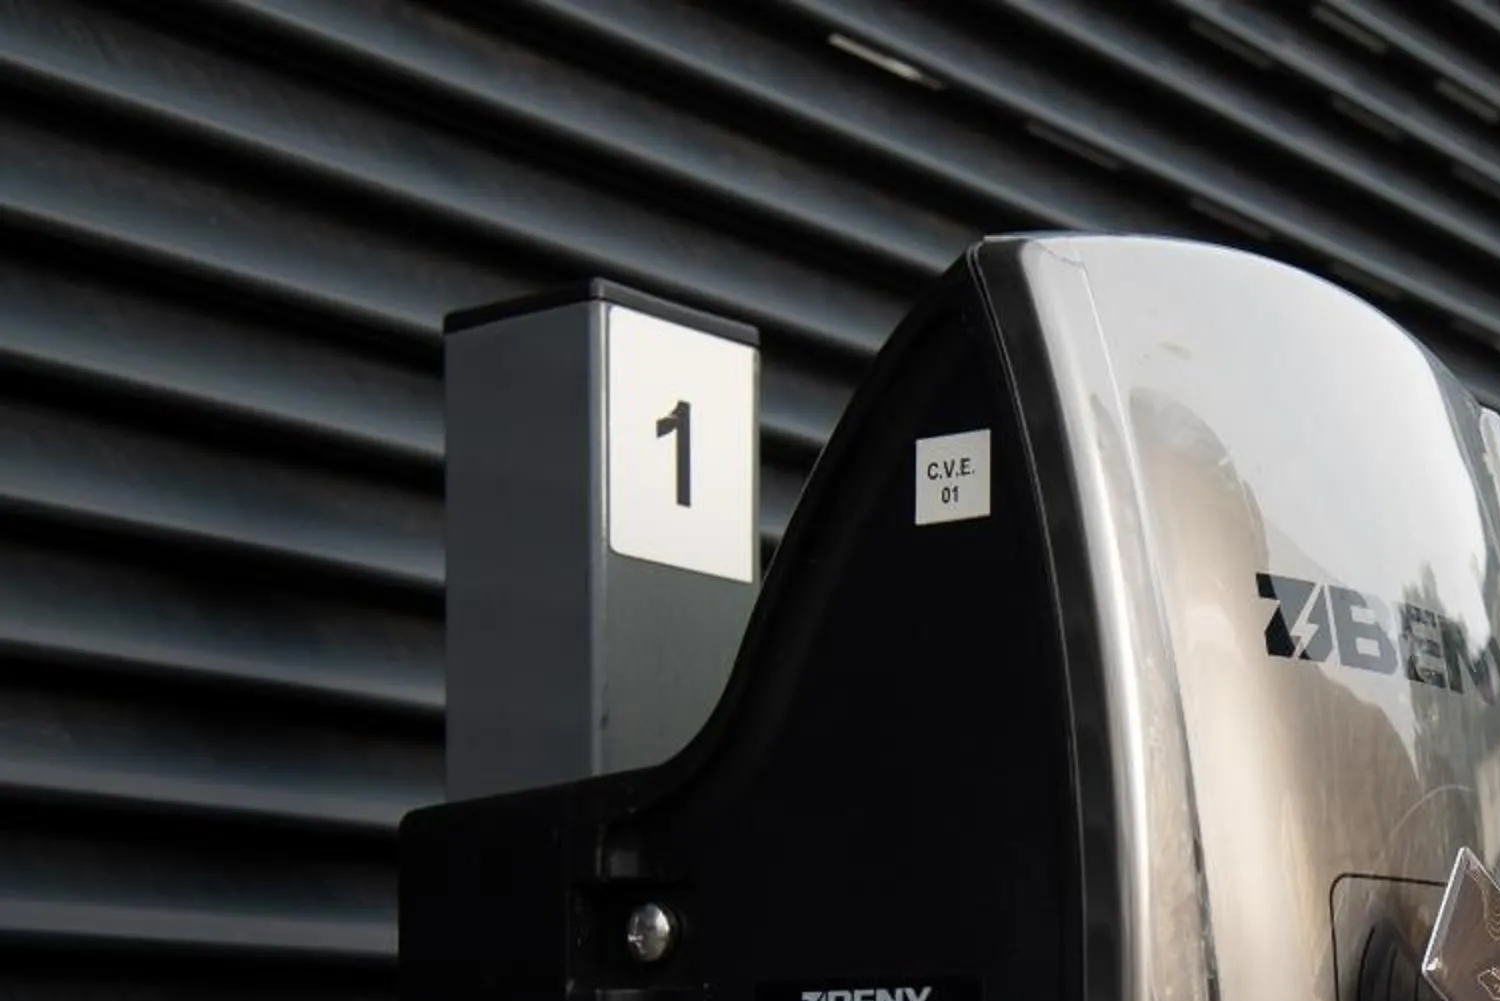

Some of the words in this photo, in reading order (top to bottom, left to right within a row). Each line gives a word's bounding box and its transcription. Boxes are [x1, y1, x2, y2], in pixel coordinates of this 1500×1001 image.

[656, 399, 691, 507] 1
[927, 457, 975, 480] C.V.E.
[941, 485, 959, 504] 01
